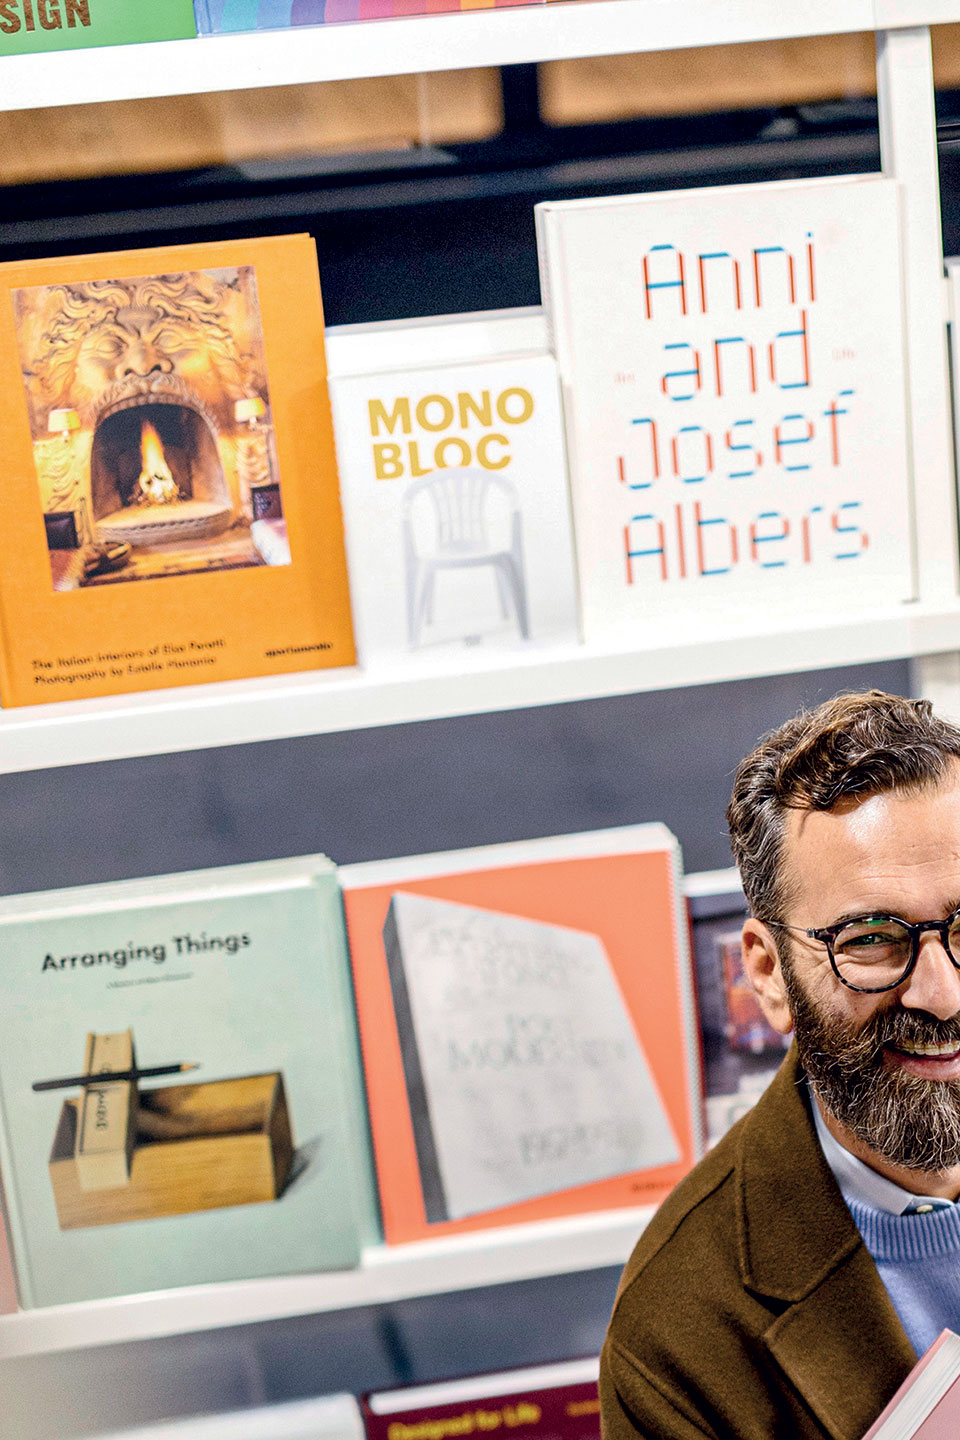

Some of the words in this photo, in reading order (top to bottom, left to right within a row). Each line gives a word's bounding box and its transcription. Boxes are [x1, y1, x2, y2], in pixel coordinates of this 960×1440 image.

[643, 231, 817, 320] Anni
[661, 309, 812, 401] and
[367, 387, 535, 437] MONO
[617, 390, 857, 490] Josef
[372, 433, 512, 480] BLOC
[624, 501, 870, 586] Albers
[41, 941, 167, 974] Arranging
[172, 932, 252, 956] Things
